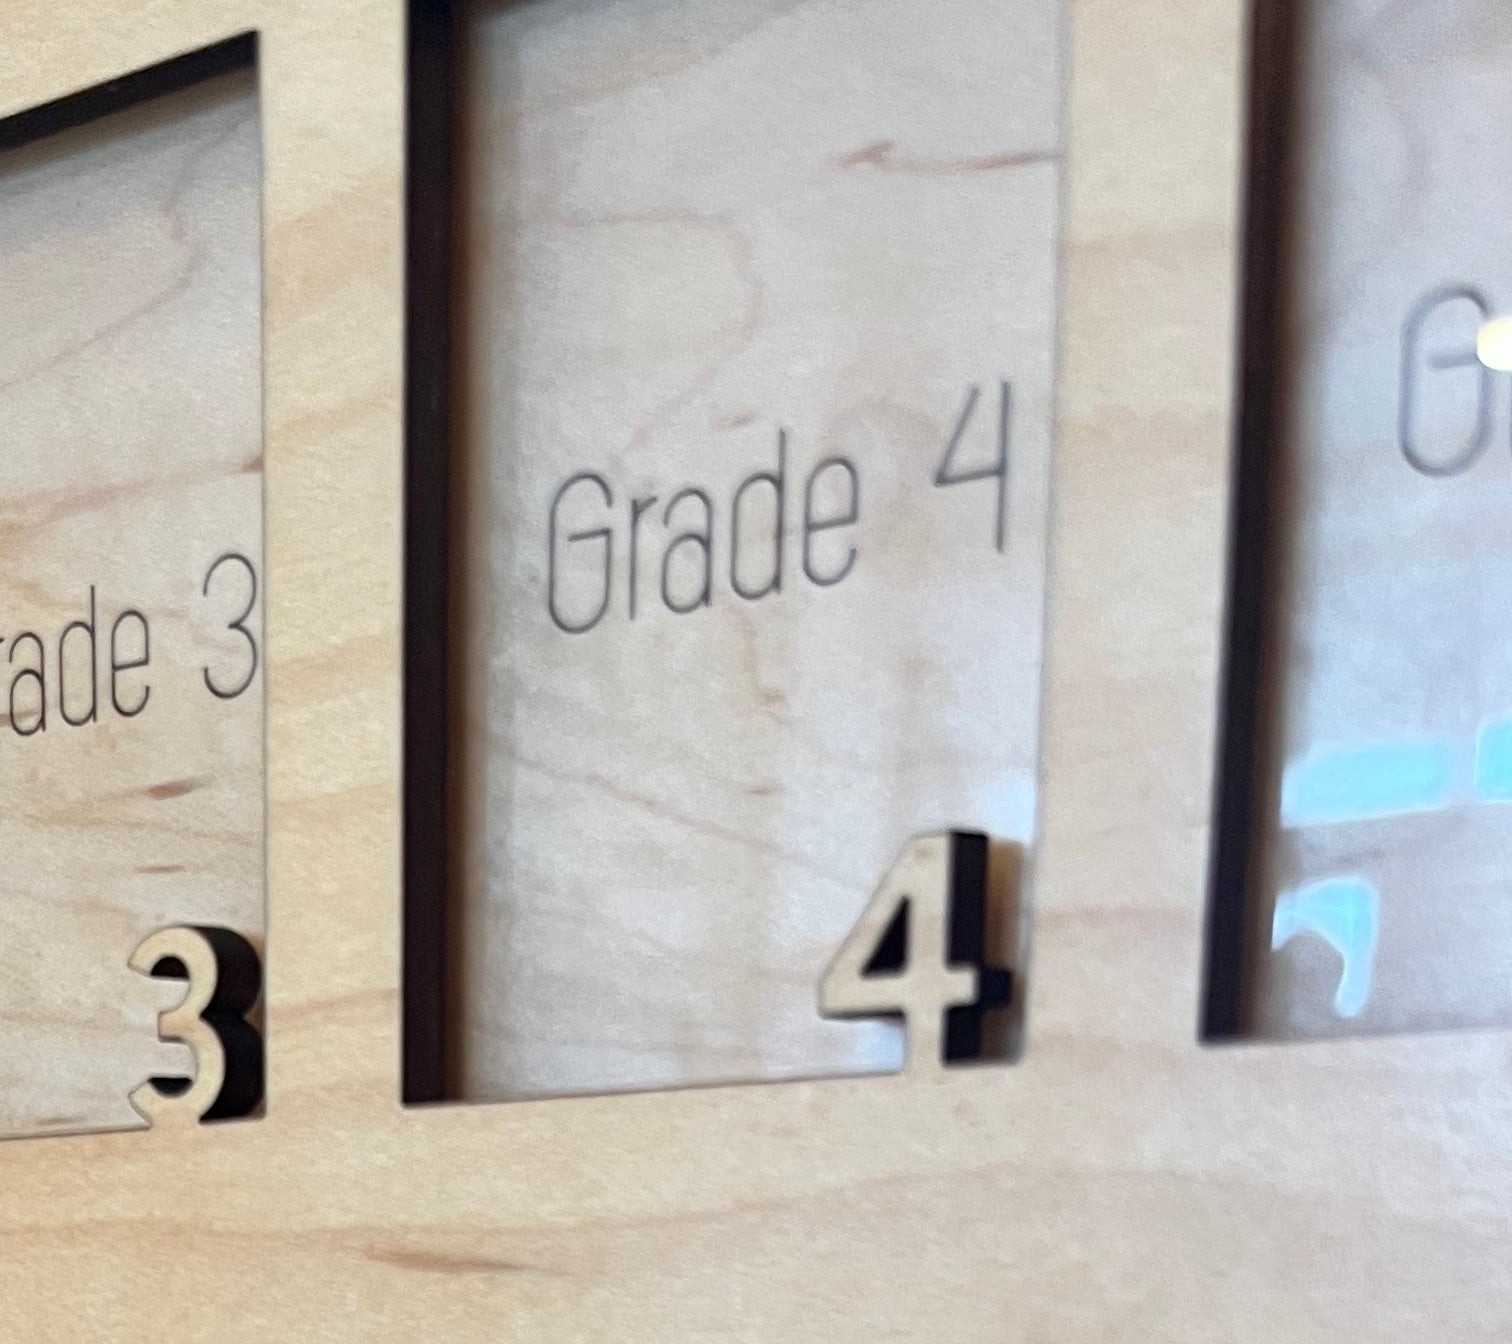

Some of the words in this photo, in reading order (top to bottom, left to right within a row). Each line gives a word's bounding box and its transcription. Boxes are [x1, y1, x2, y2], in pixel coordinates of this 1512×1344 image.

[549, 428, 859, 634] Grade
[935, 380, 1011, 553] 4
[203, 553, 258, 699] 3
[128, 925, 238, 1126] 3
[818, 829, 993, 1068] 4
